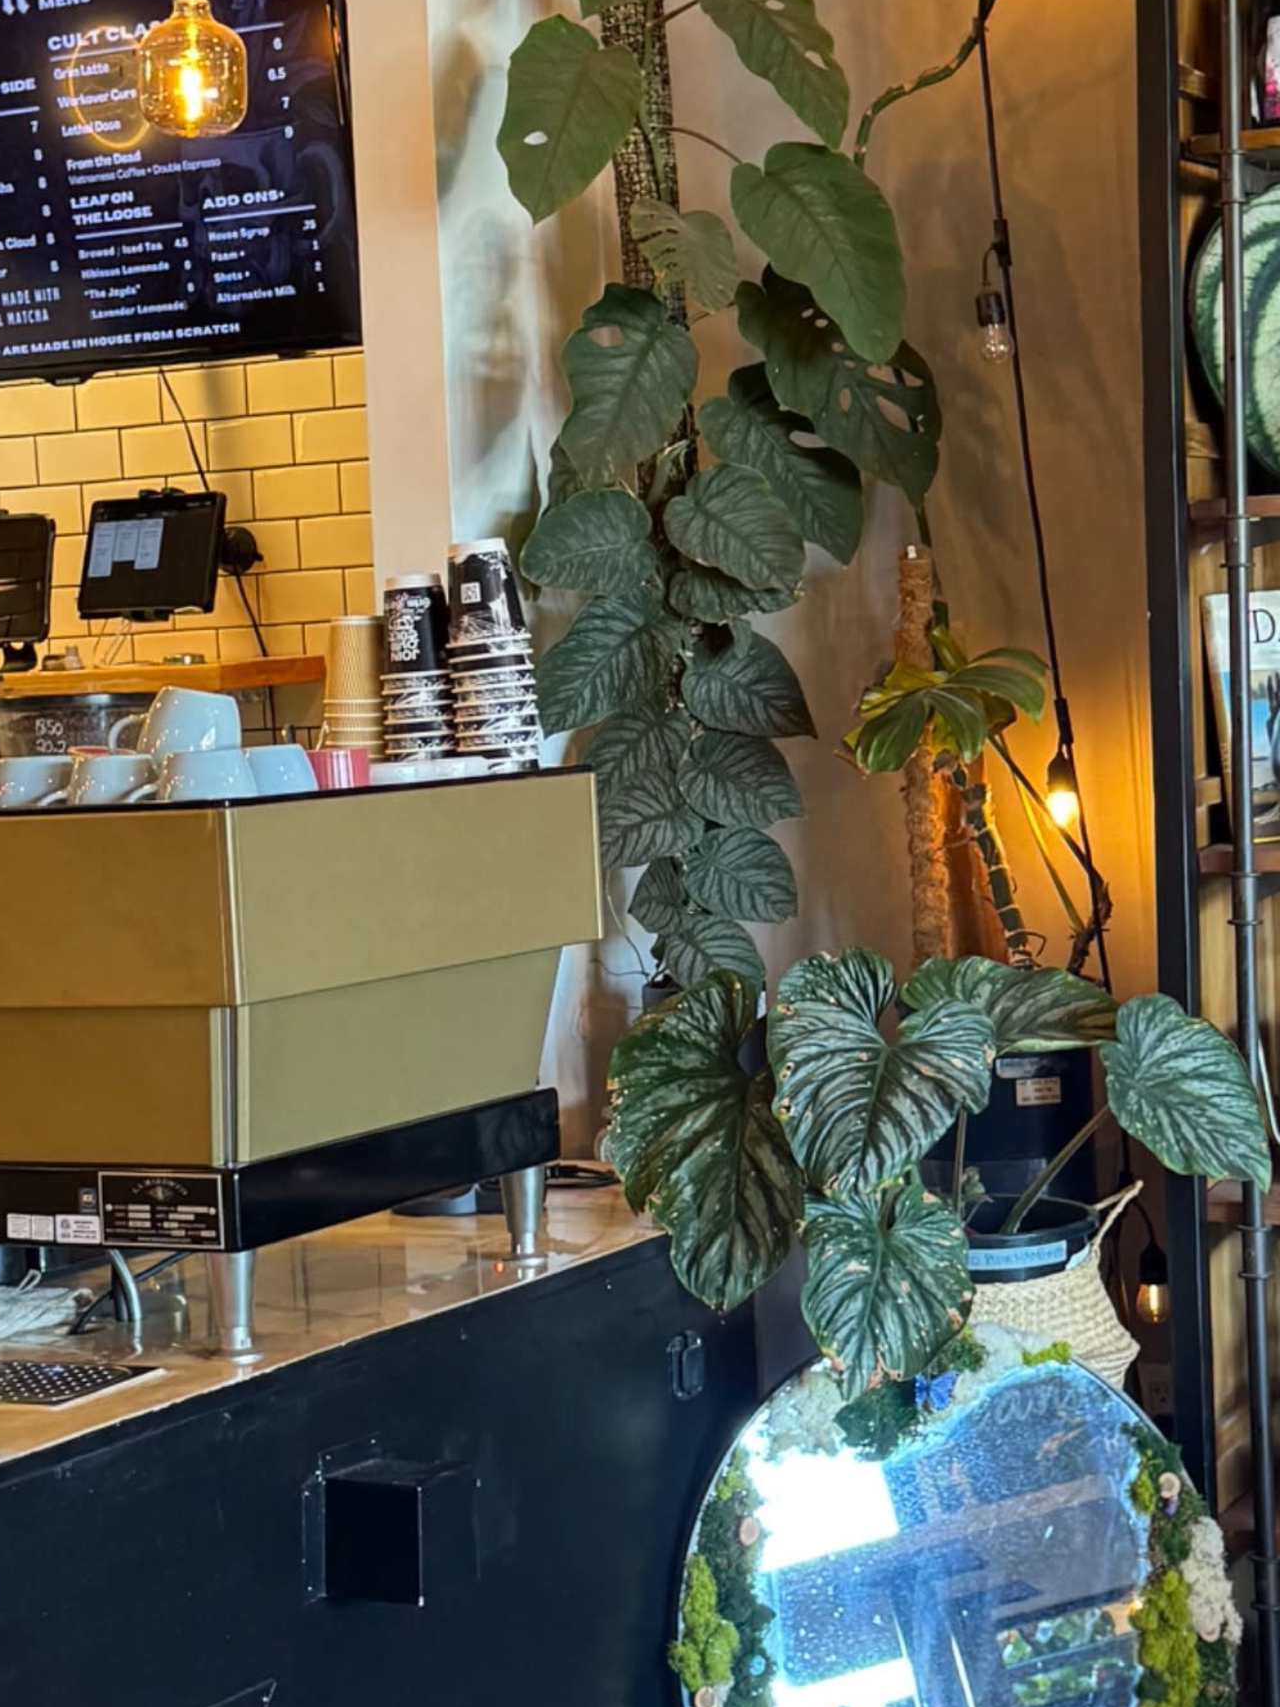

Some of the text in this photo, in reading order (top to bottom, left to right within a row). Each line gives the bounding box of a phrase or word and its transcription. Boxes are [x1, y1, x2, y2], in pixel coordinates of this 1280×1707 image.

[47, 29, 99, 51] CULT
[0, 77, 37, 94] SIDE
[30, 120, 39, 133] 7
[66, 157, 94, 172] From
[95, 153, 111, 168] the
[70, 191, 134, 209] LEAF ON
[203, 195, 240, 210] ADD
[72, 206, 153, 226] THE LOOSE
[5, 234, 36, 250] Cloud
[0, 289, 31, 306] MADE
[33, 287, 60, 303] WITH
[6, 308, 49, 326] MATCHA
[2, 344, 29, 357] ARE
[31, 340, 70, 353] MADE
[72, 338, 87, 350] IN
[89, 333, 132, 348] HOUSE
[133, 328, 173, 343] FROM
[175, 322, 240, 338] SCRATCH
[390, 649, 420, 663] JOIN
